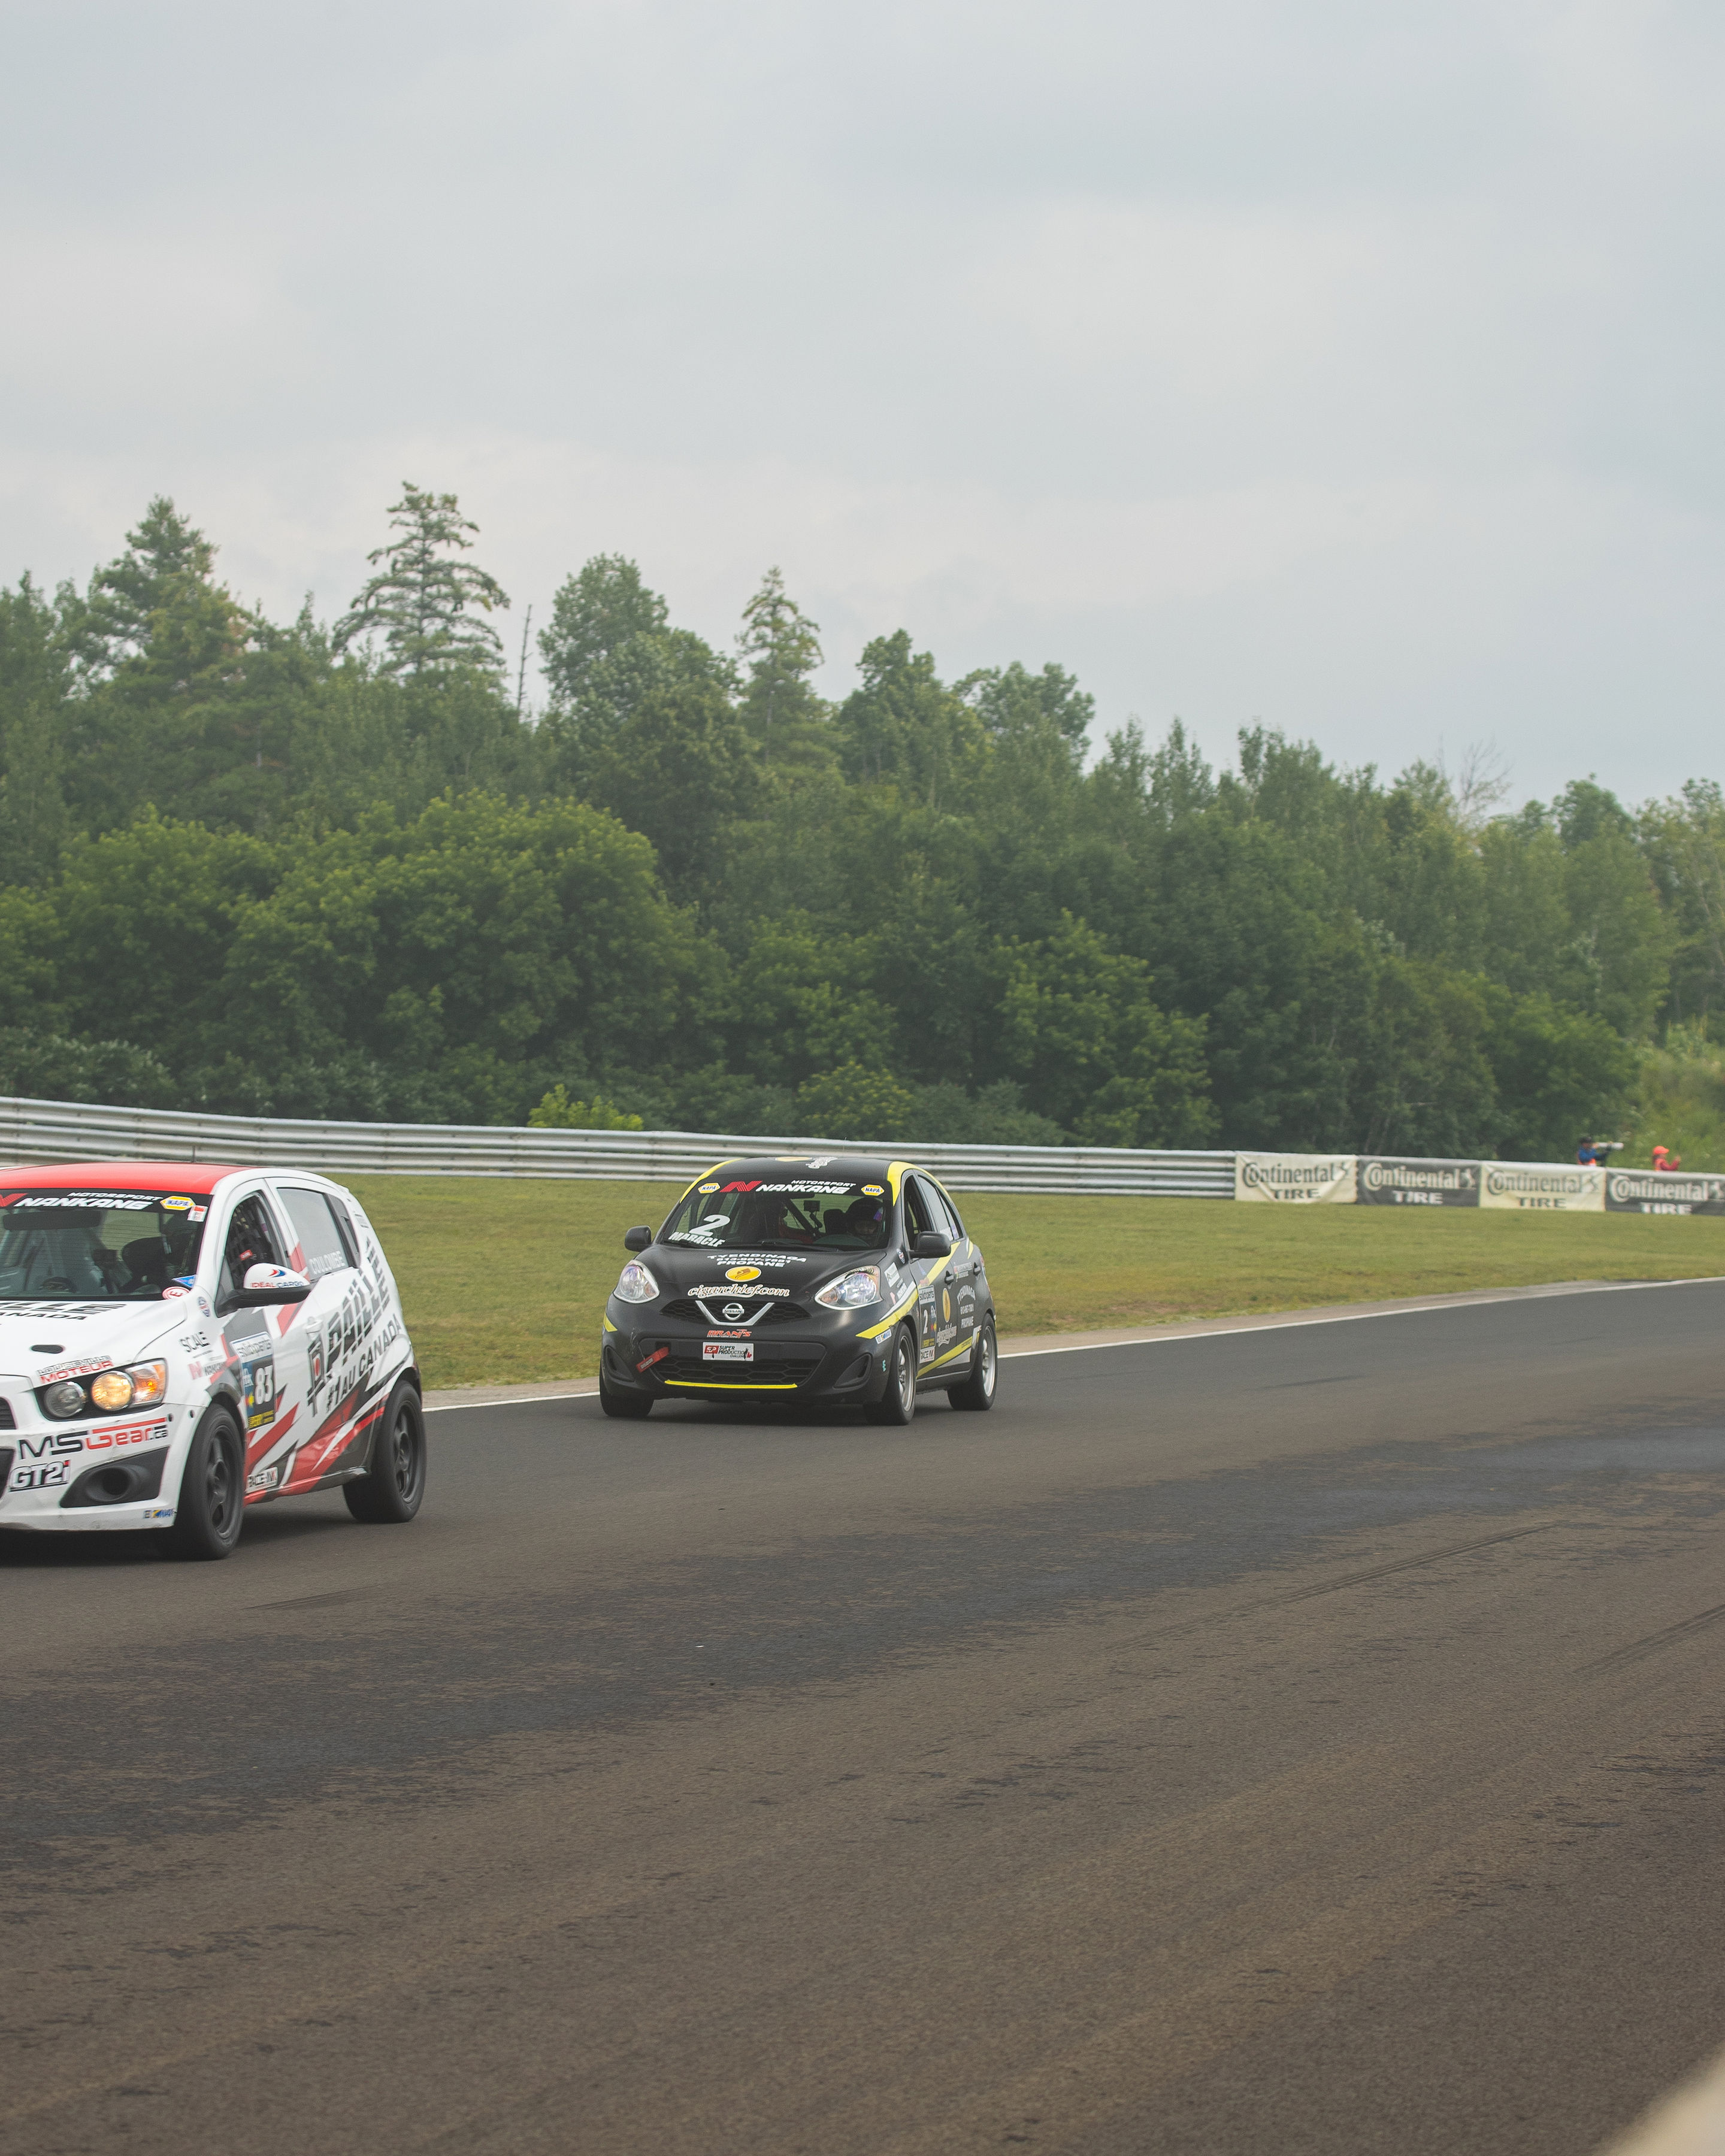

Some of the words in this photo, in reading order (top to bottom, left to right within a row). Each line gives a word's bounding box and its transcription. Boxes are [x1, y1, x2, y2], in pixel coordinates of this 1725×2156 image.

[1242, 1162, 1334, 1187] Continental
[1364, 1162, 1460, 1191] Continental
[1487, 1170, 1582, 1195] Continental
[67, 1192, 164, 1201] MOTORSPORT
[755, 1184, 851, 1194] NANKANG
[1272, 1189, 1321, 1199] TIRE
[1392, 1190, 1443, 1204] TIRE
[1610, 1174, 1708, 1203] Continental
[14, 1198, 153, 1210] NANKANG
[1518, 1197, 1566, 1208] TIRE
[1640, 1202, 1692, 1215] TIRE
[689, 1215, 731, 1237] 2
[668, 1231, 727, 1247] MARACLE
[309, 1251, 345, 1275] COULOMBE
[707, 1253, 807, 1262] TYENDINAGA
[688, 1283, 790, 1298] cigarchief.com
[923, 1309, 928, 1334] 2
[359, 1313, 402, 1377] CANADA
[40, 1360, 114, 1384] MOTEUR
[255, 1365, 274, 1405] 83
